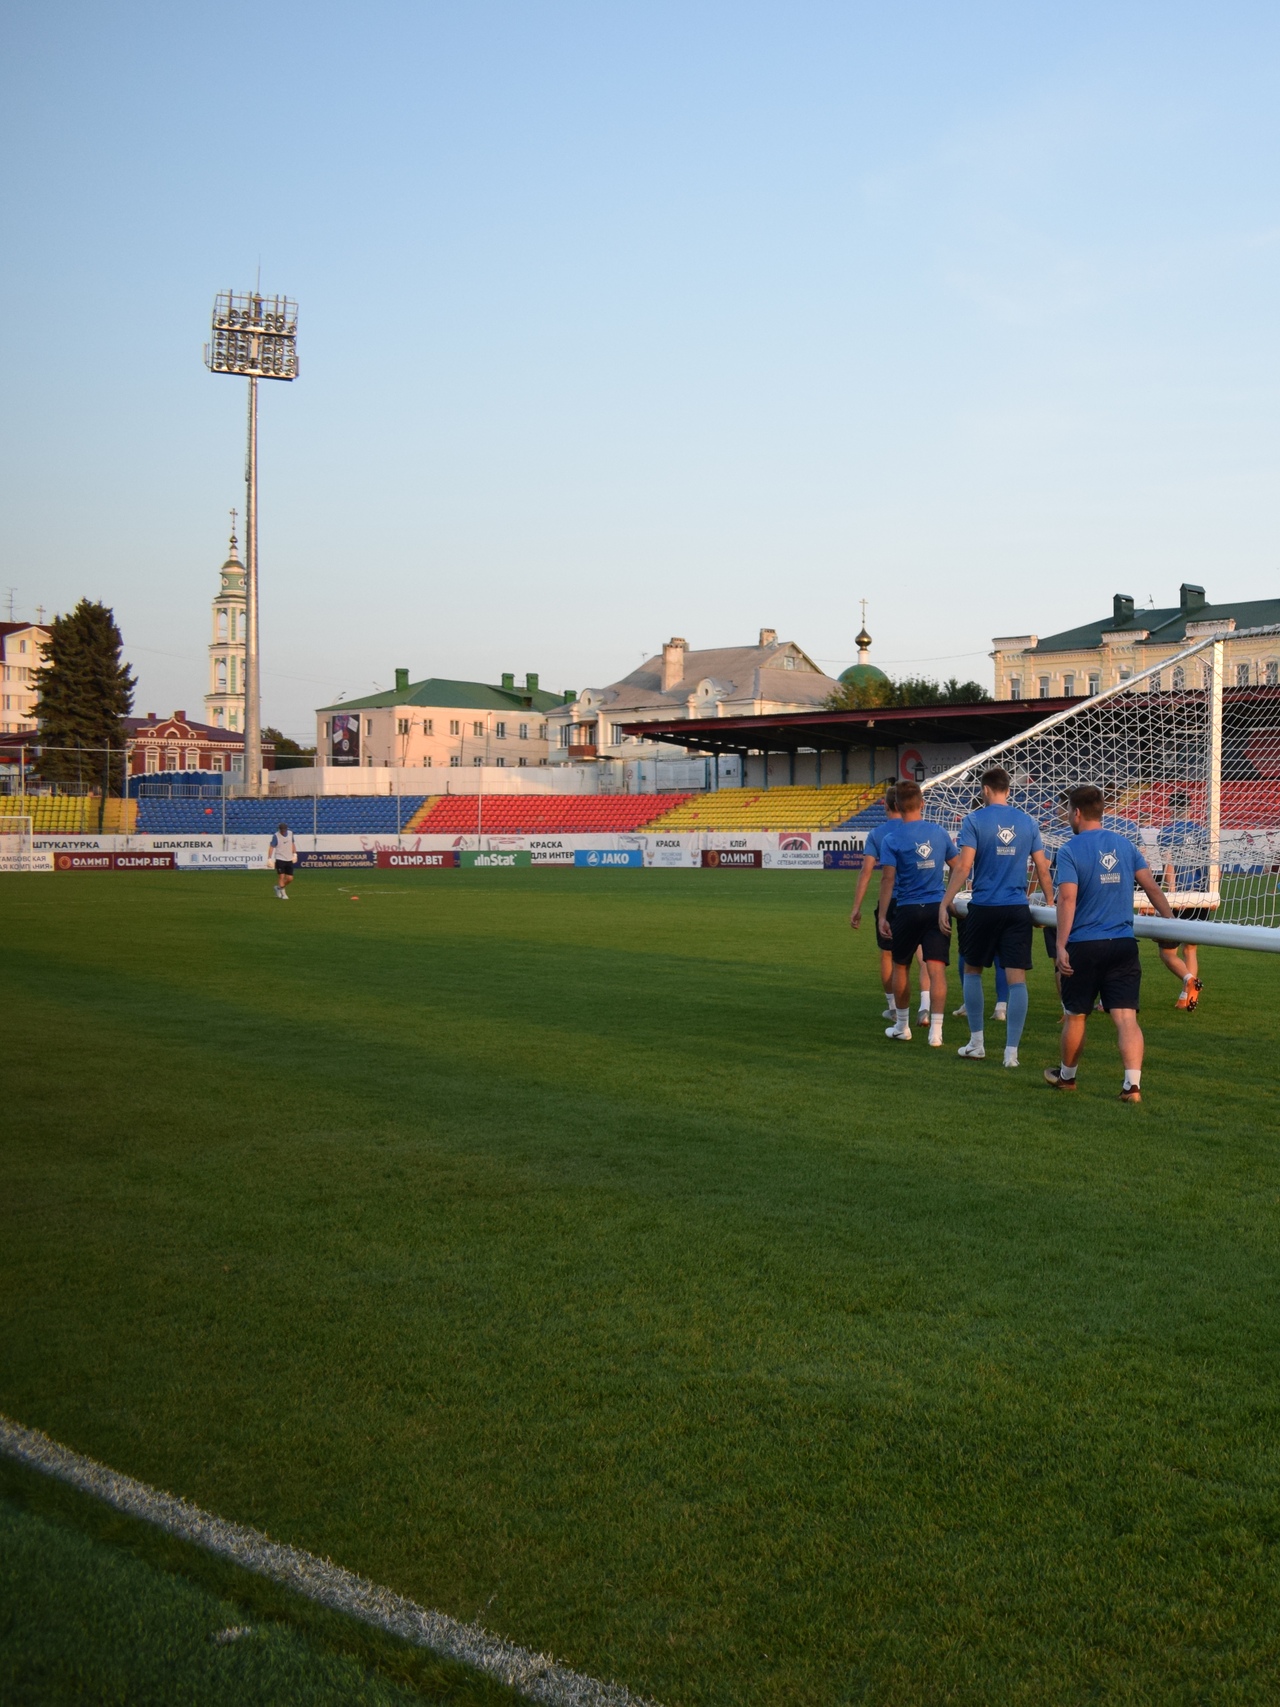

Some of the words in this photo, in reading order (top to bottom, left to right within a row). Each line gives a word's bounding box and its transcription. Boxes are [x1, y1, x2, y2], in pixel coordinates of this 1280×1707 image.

[32, 841, 100, 849] ШТУКАТУРКА
[153, 841, 213, 849] ШПАКЛЕВКА
[655, 840, 681, 848] КРАСКА
[729, 838, 747, 848] КЛЕЙ
[72, 857, 109, 866] ОЛИМП
[116, 857, 171, 866] OLIMP.BET
[202, 854, 263, 865] Мостострой
[389, 855, 443, 865] OLIMP.BET
[601, 853, 629, 864] JAKO
[720, 853, 754, 863] ОЛИМП
